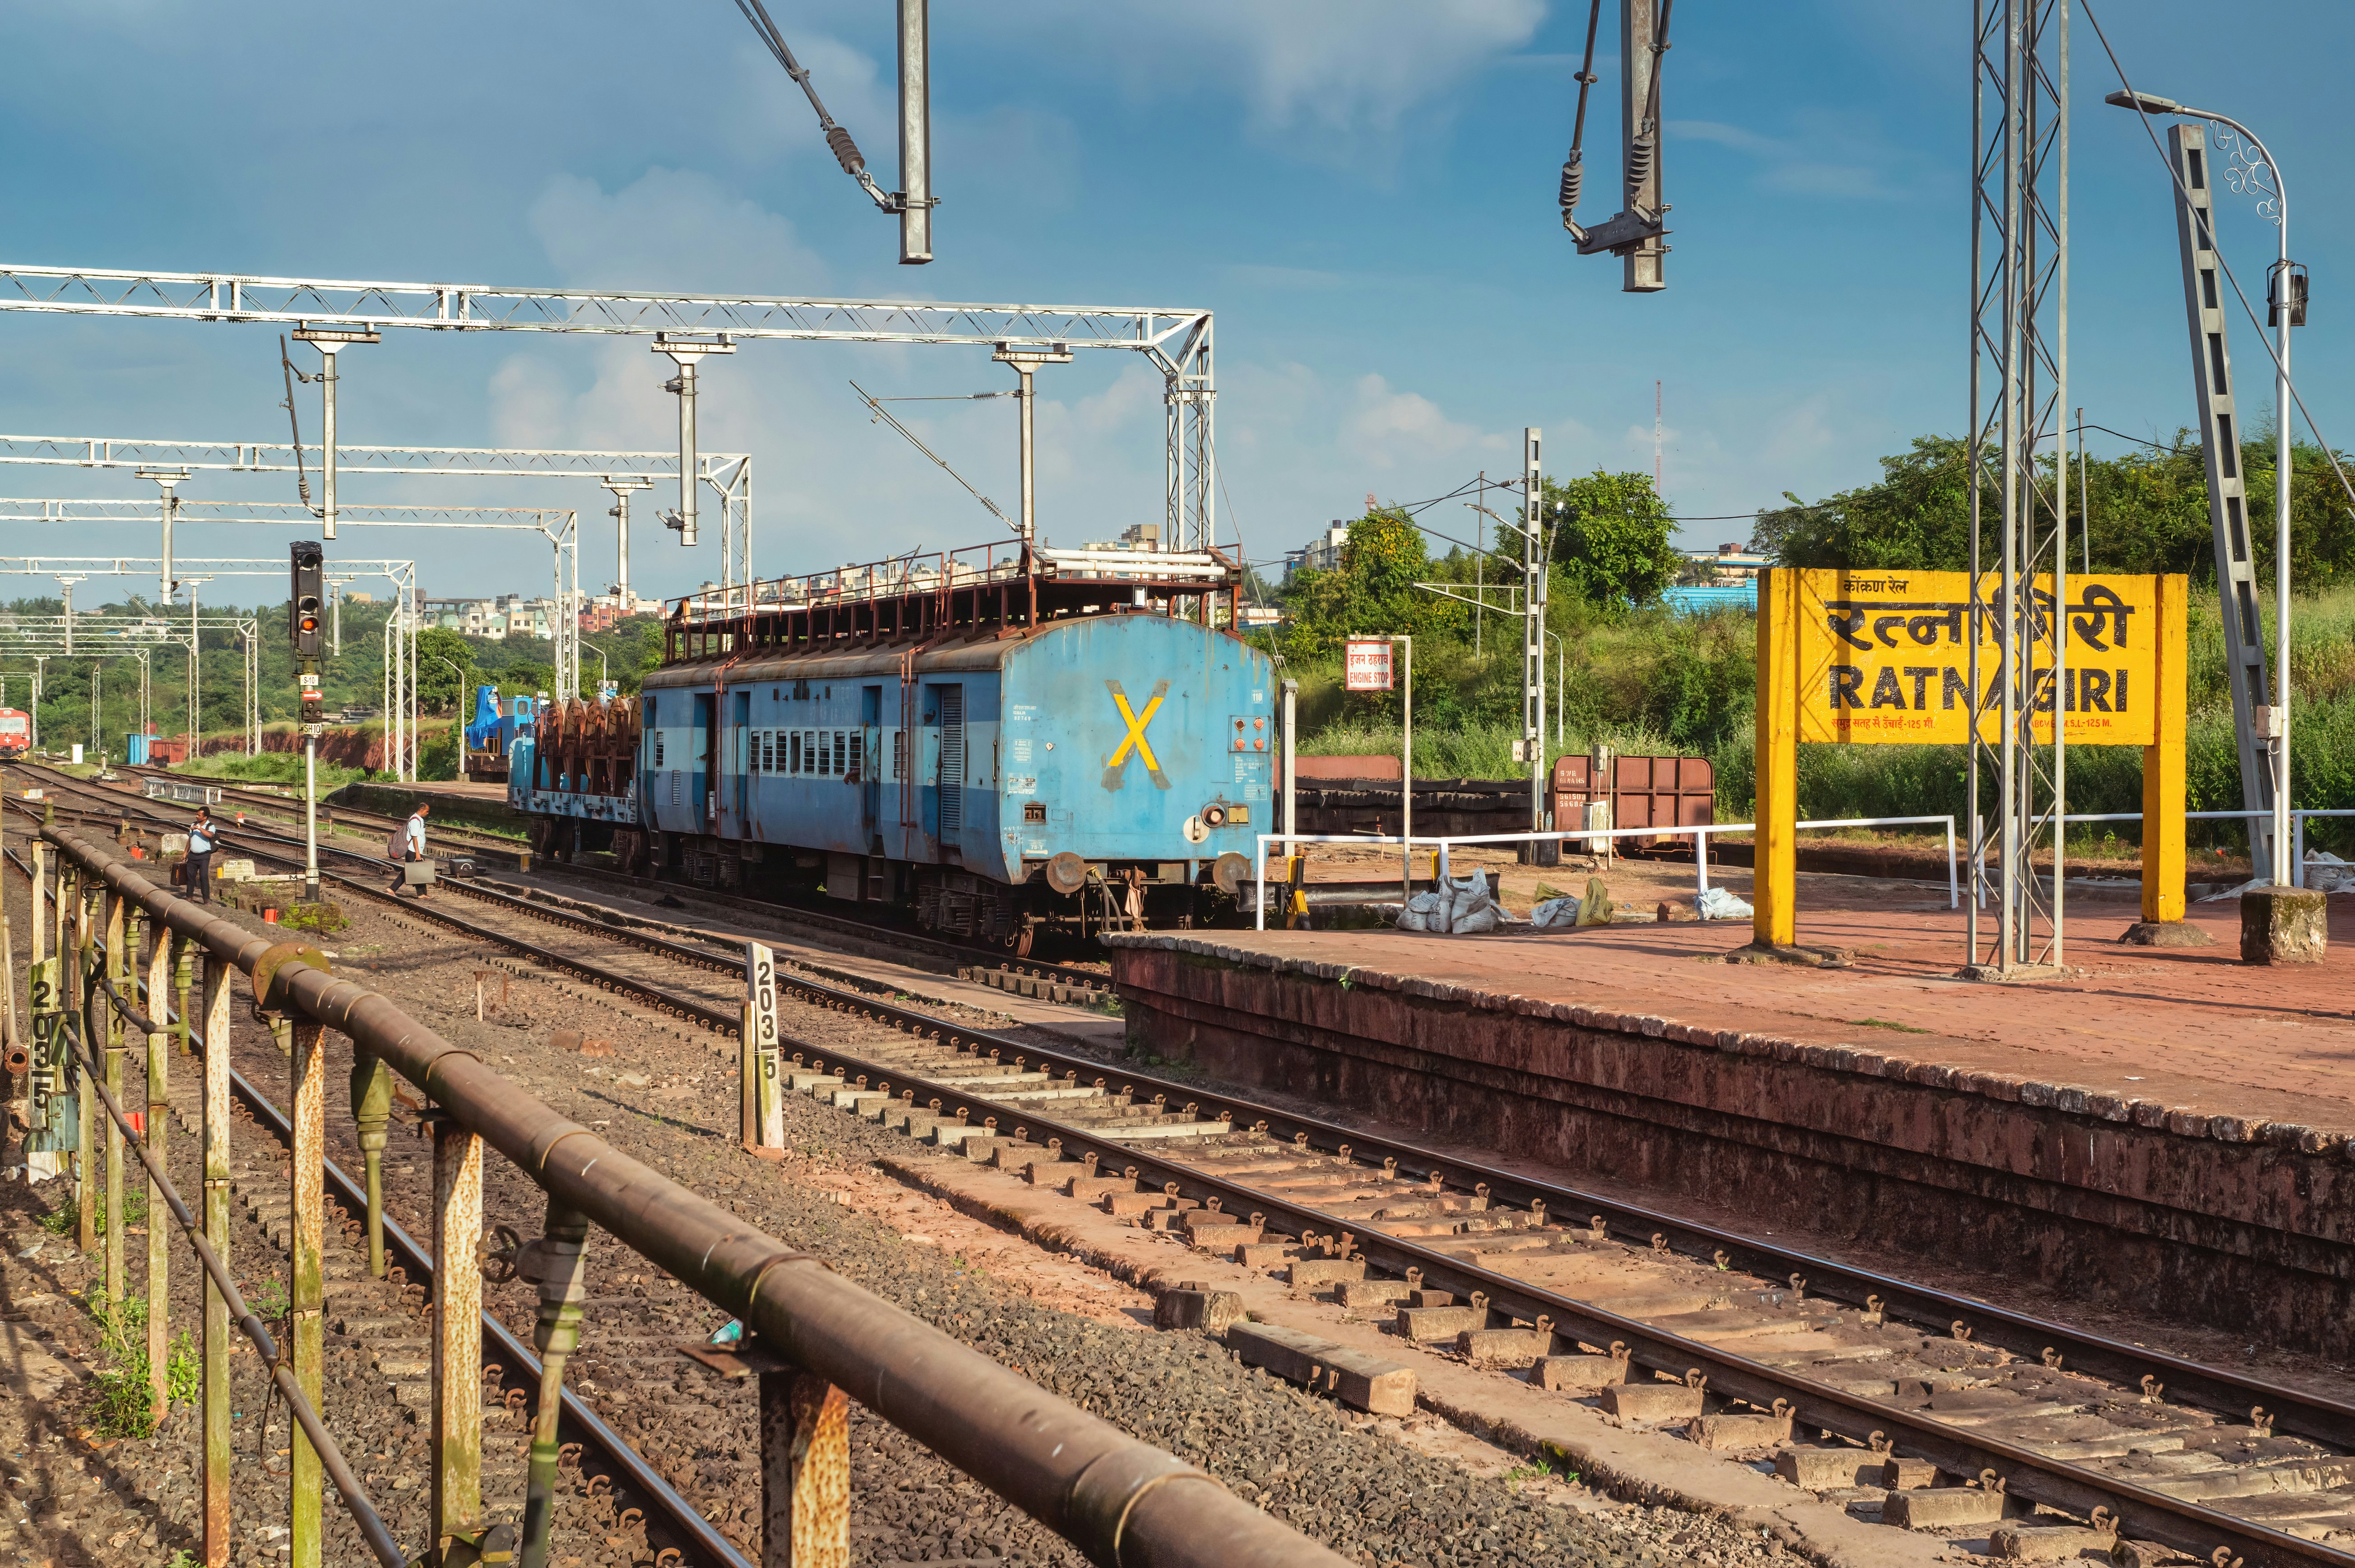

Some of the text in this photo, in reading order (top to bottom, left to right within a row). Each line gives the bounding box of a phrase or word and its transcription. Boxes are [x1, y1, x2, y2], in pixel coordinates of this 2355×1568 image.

[1843, 575, 1909, 594] कोंकण रेल
[1349, 649, 1389, 669] इंजन ठहराव
[1350, 672, 1389, 683] ENGINE STOP
[1852, 719, 1871, 730] सतह
[1872, 715, 1881, 728] से
[764, 1054, 776, 1080] 5
